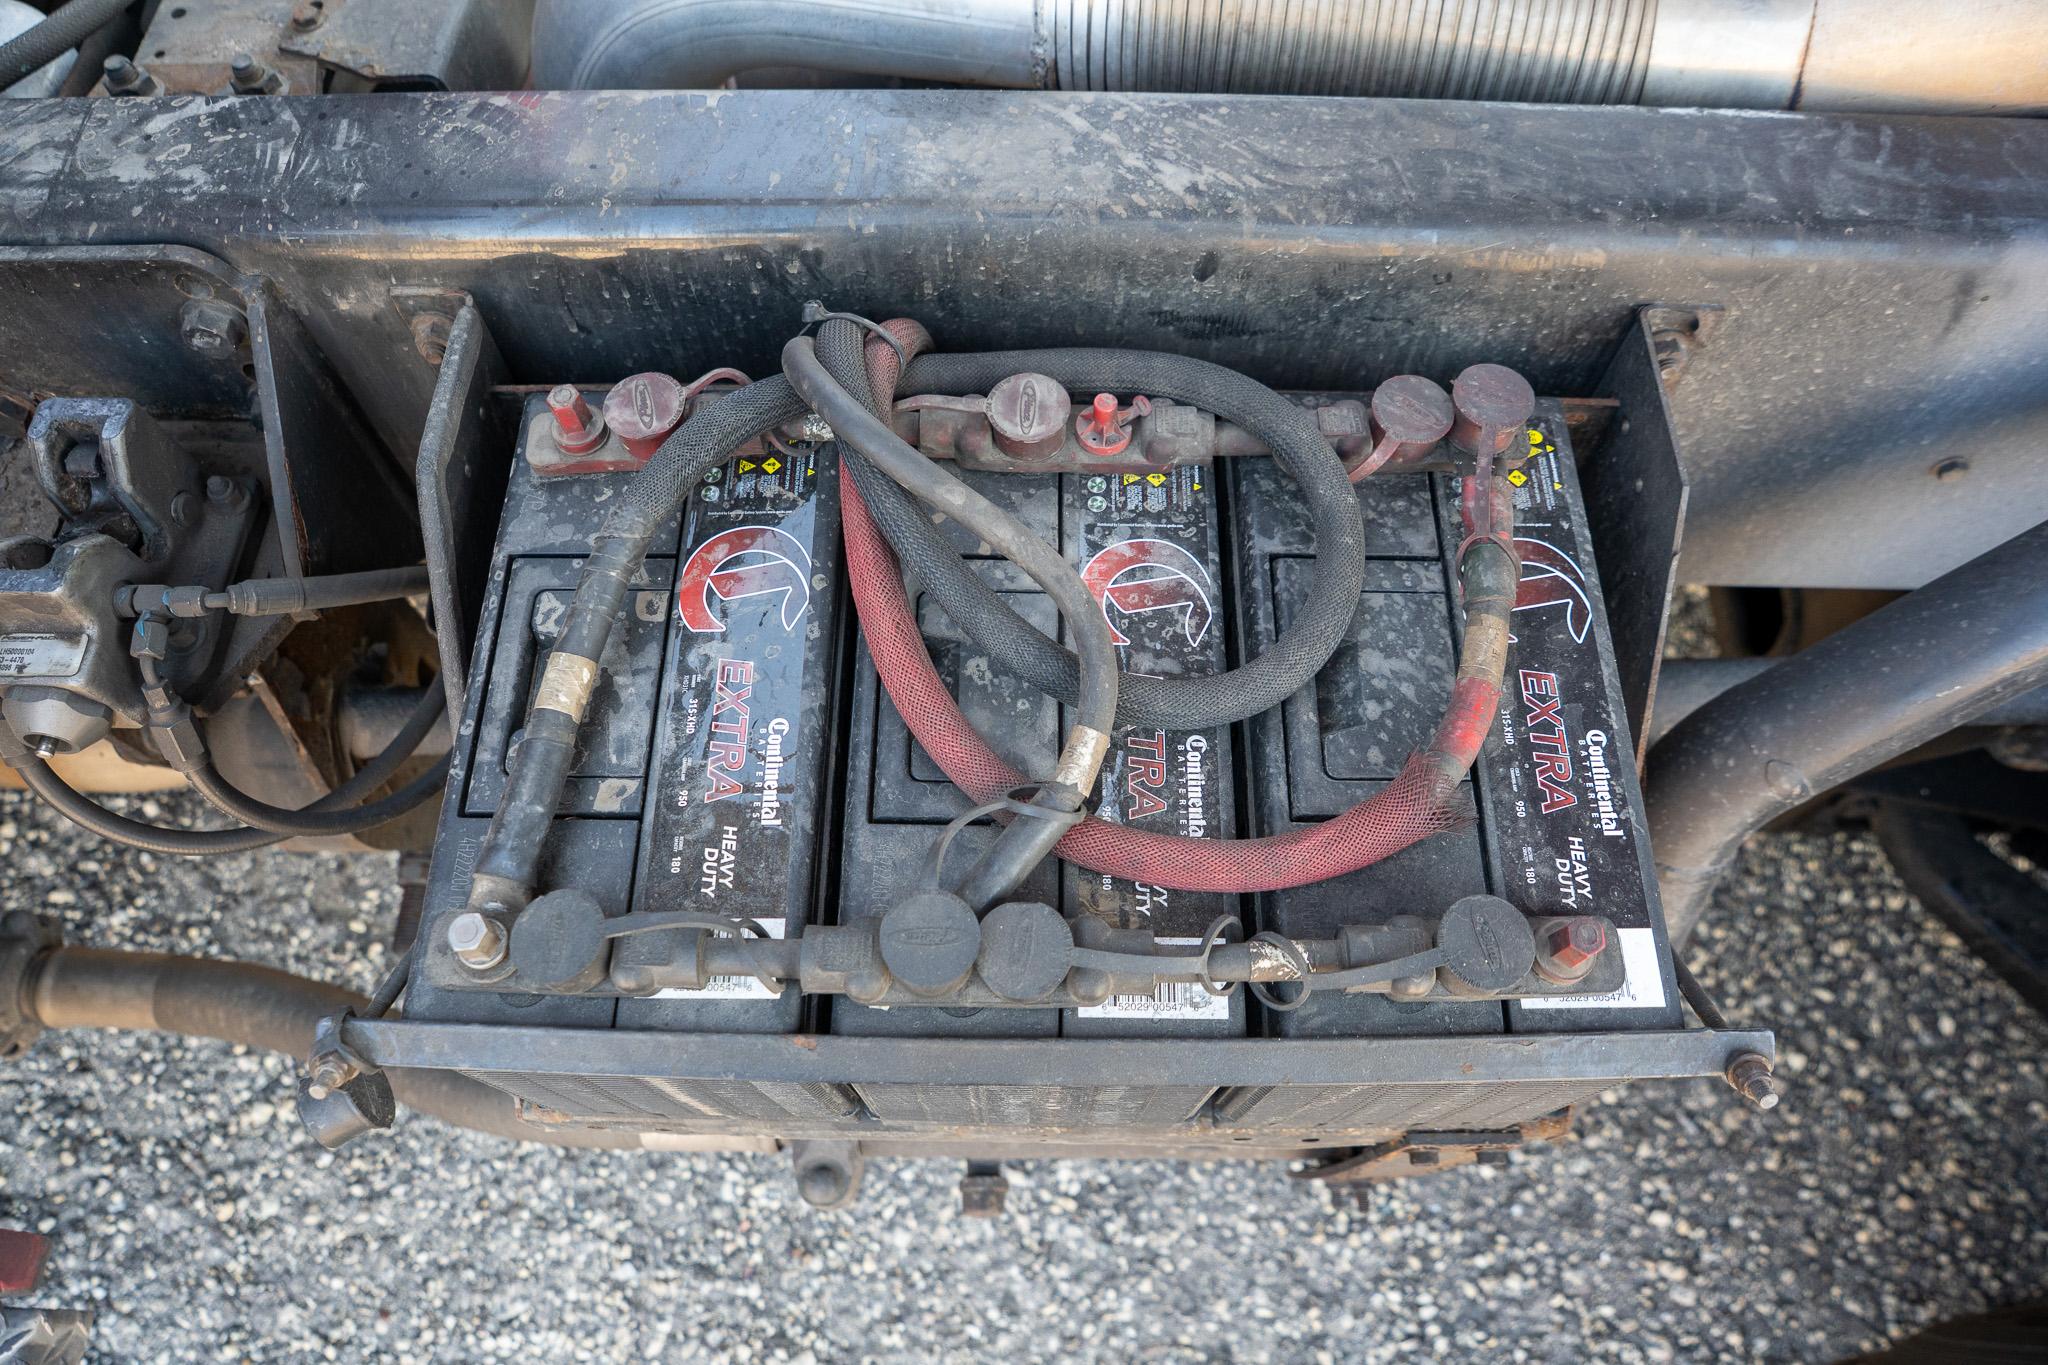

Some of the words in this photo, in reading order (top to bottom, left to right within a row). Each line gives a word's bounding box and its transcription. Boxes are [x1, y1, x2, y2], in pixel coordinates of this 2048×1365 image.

[704, 658, 754, 804] EXTRA
[1519, 669, 1577, 815] EXTRA
[678, 789, 688, 807] 950
[751, 728, 767, 819] BATTERIES
[760, 717, 790, 826] Continental
[1128, 724, 1167, 820] TRA
[1177, 744, 1188, 836] BATTERIES
[1186, 734, 1210, 840] Continenta
[1578, 739, 1601, 830] BATTERIES
[1585, 729, 1624, 837] Continental
[1515, 800, 1526, 818] 950
[671, 856, 682, 873] 180
[700, 847, 720, 899] DUTY
[718, 825, 738, 889] HEAVY
[1525, 867, 1536, 884] 180
[1555, 857, 1578, 909] DUTY
[1567, 836, 1593, 899] HEAVY
[1134, 881, 1151, 917] UTY
[1118, 1002, 1149, 1011] 52029
[1152, 1002, 1184, 1011] 00547
